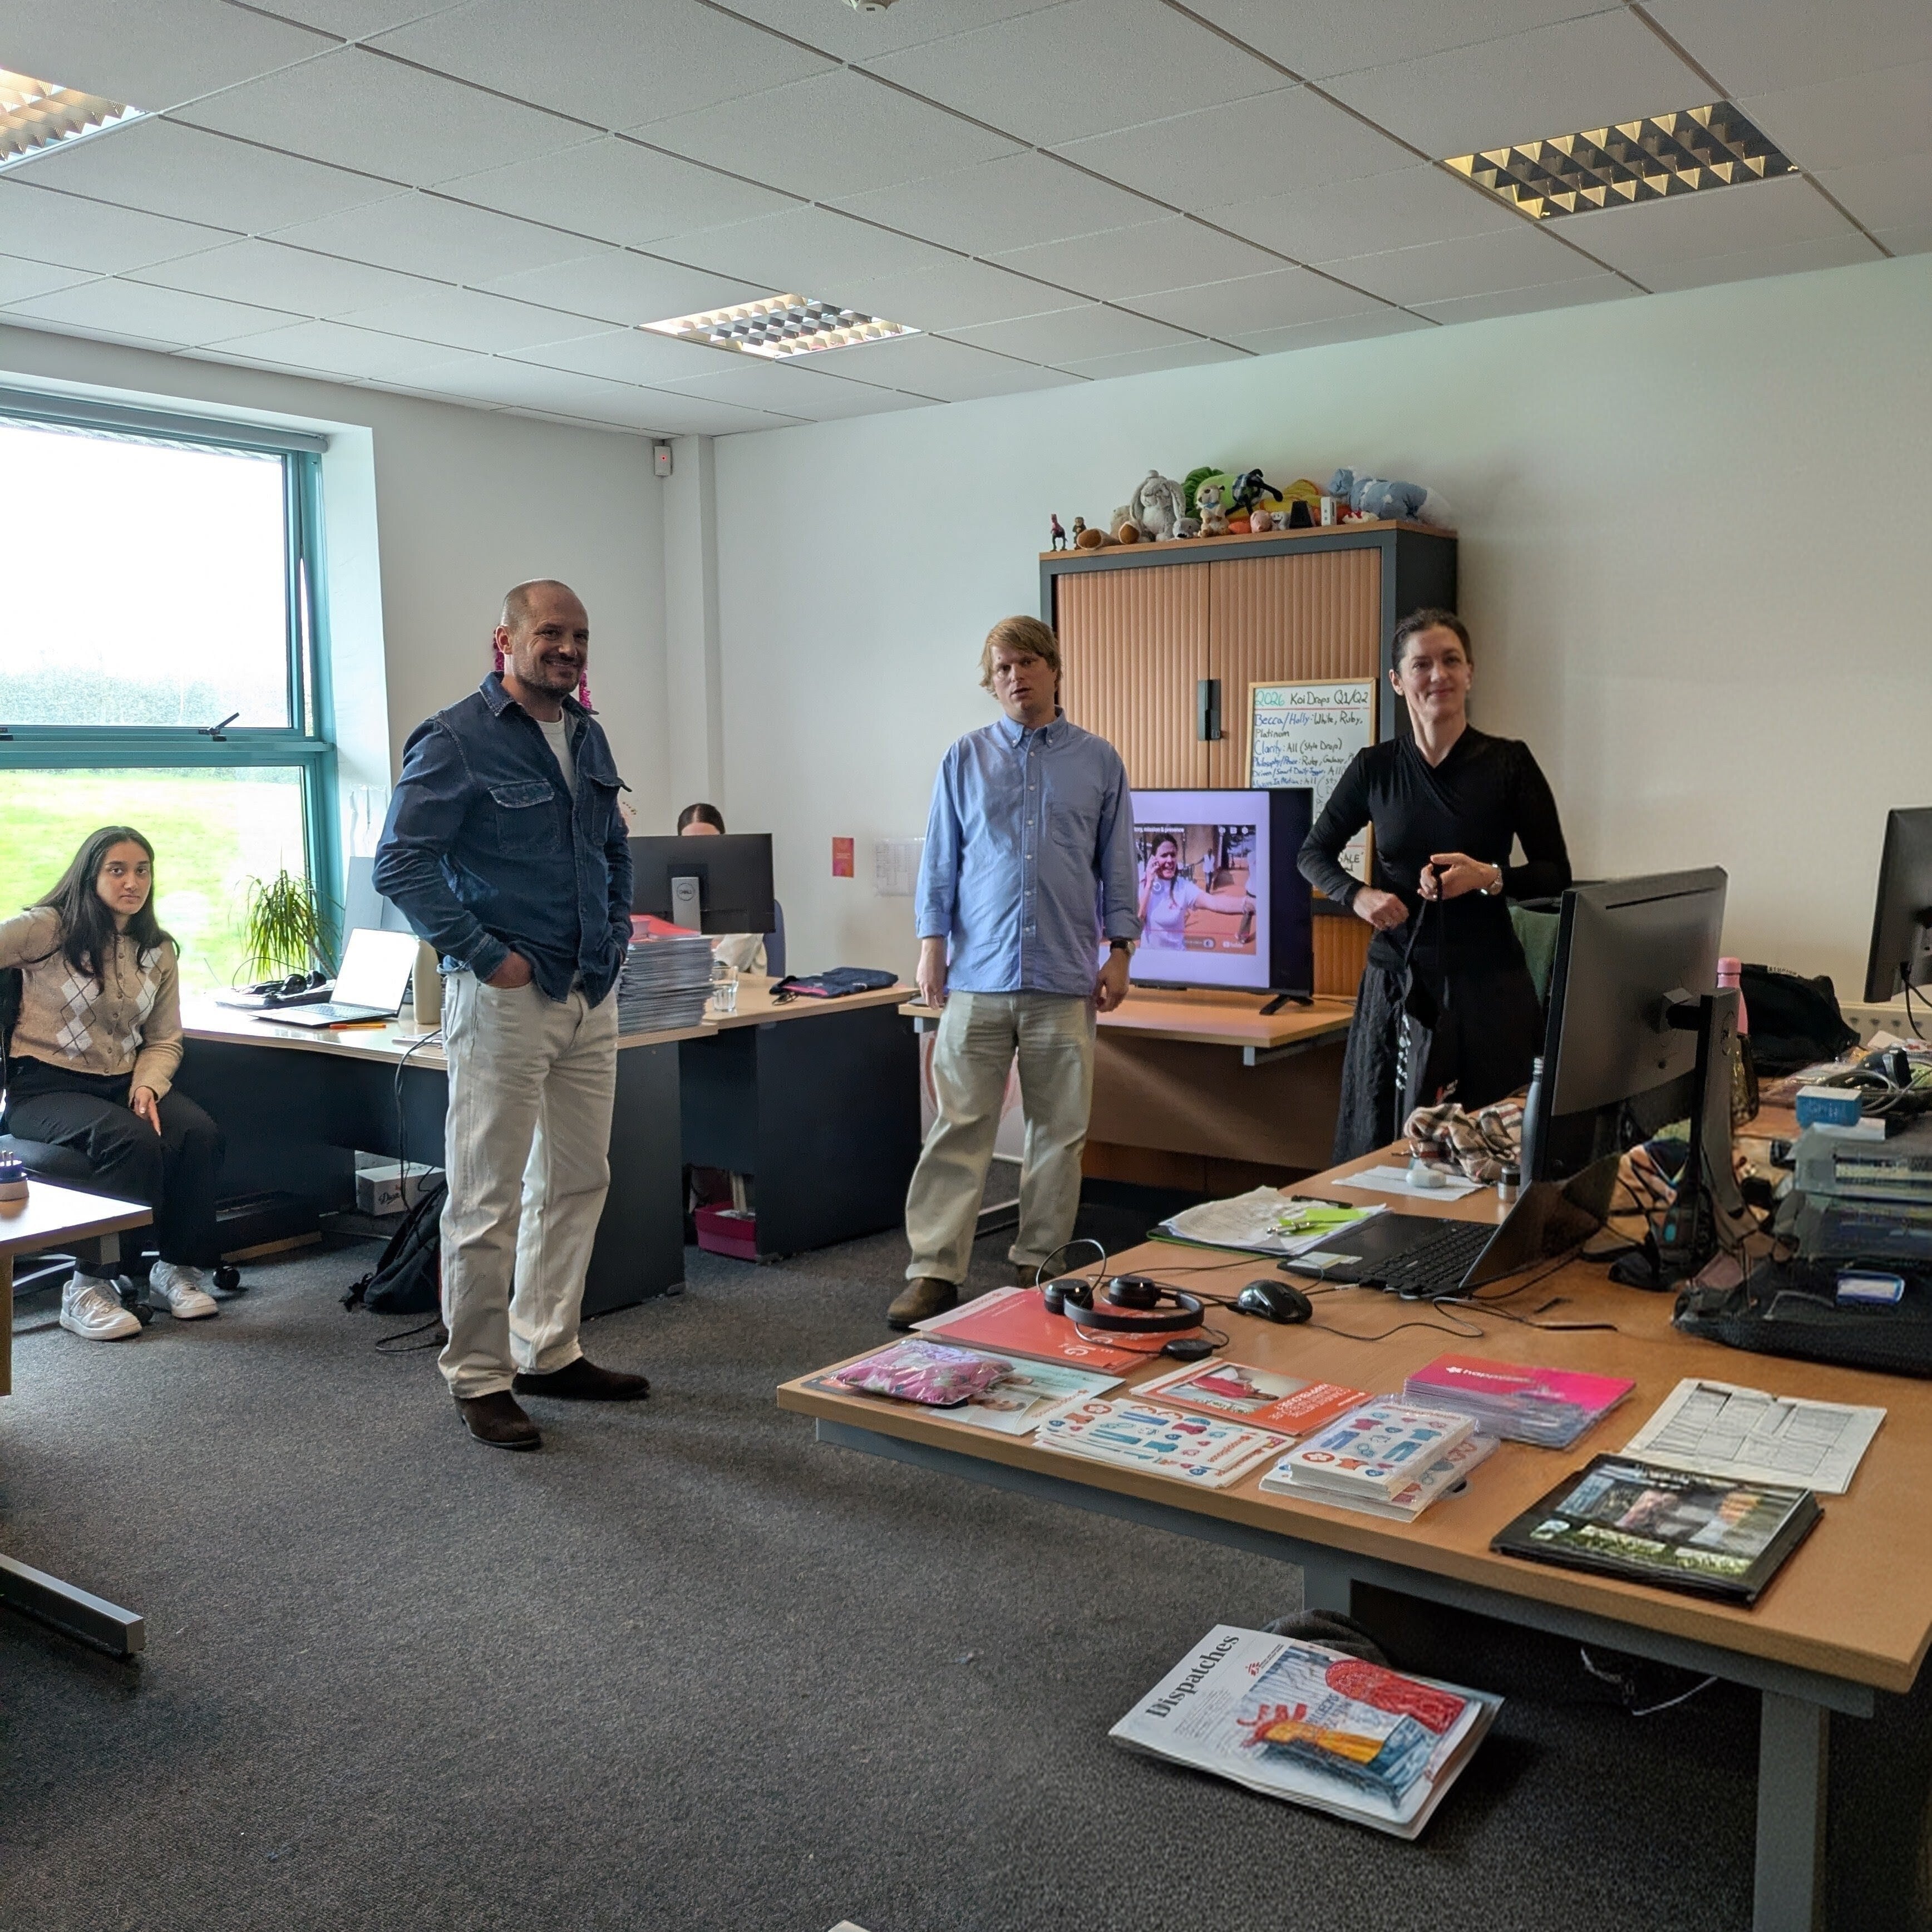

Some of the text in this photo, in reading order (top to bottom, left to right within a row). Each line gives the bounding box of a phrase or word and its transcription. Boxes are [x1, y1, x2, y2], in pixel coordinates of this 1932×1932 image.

[1255, 689, 1368, 706] 2026 Koi Drops Q1/Q2
[1287, 742, 1298, 752] All
[1145, 1635, 1239, 1718] Dispatches
